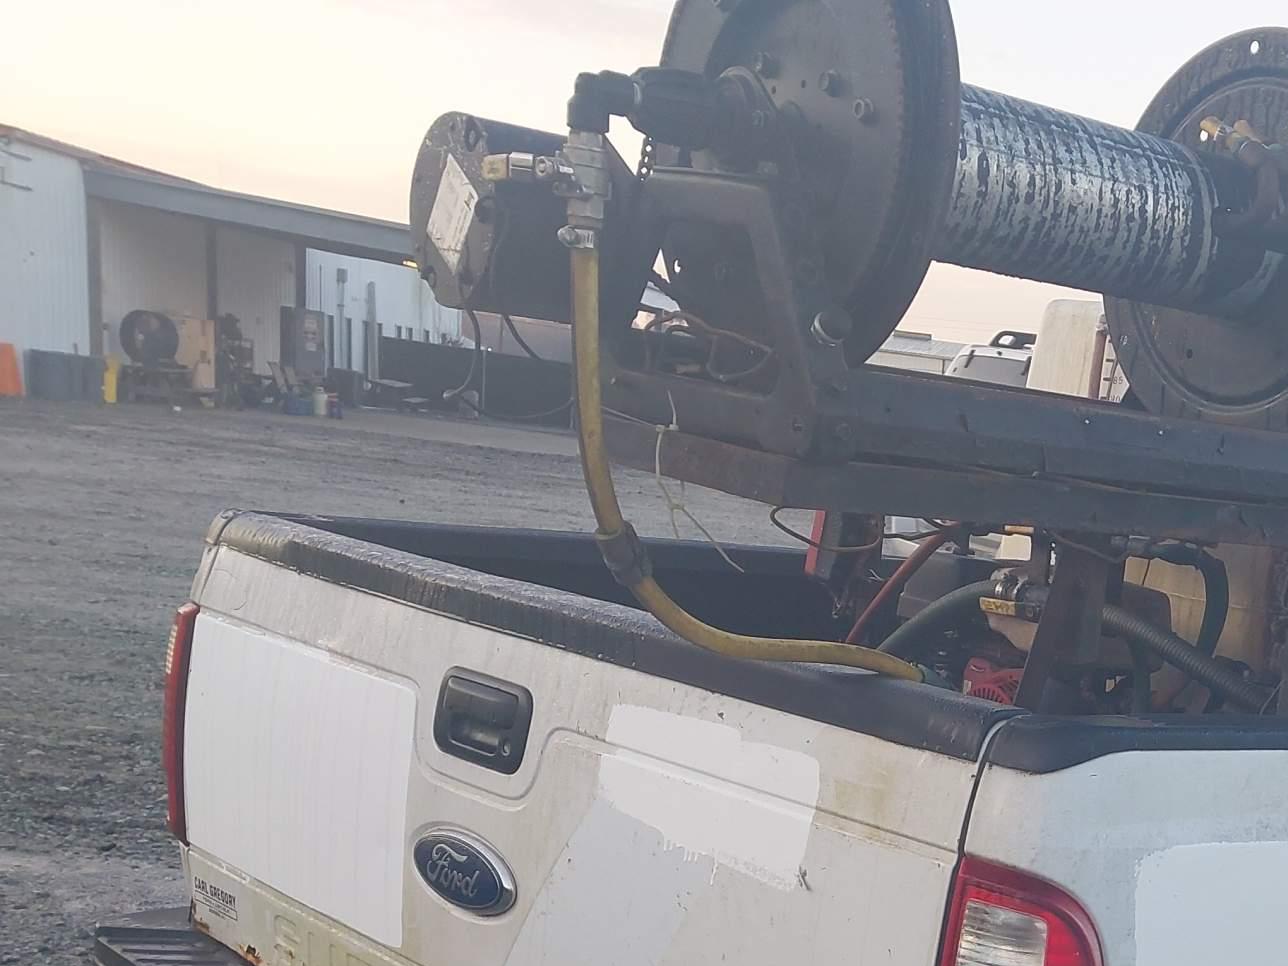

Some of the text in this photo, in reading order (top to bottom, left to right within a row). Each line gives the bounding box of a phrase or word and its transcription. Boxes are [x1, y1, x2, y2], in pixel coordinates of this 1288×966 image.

[426, 843, 480, 897] Ford
[194, 876, 209, 895] CARL
[209, 884, 236, 909] GREGORY
